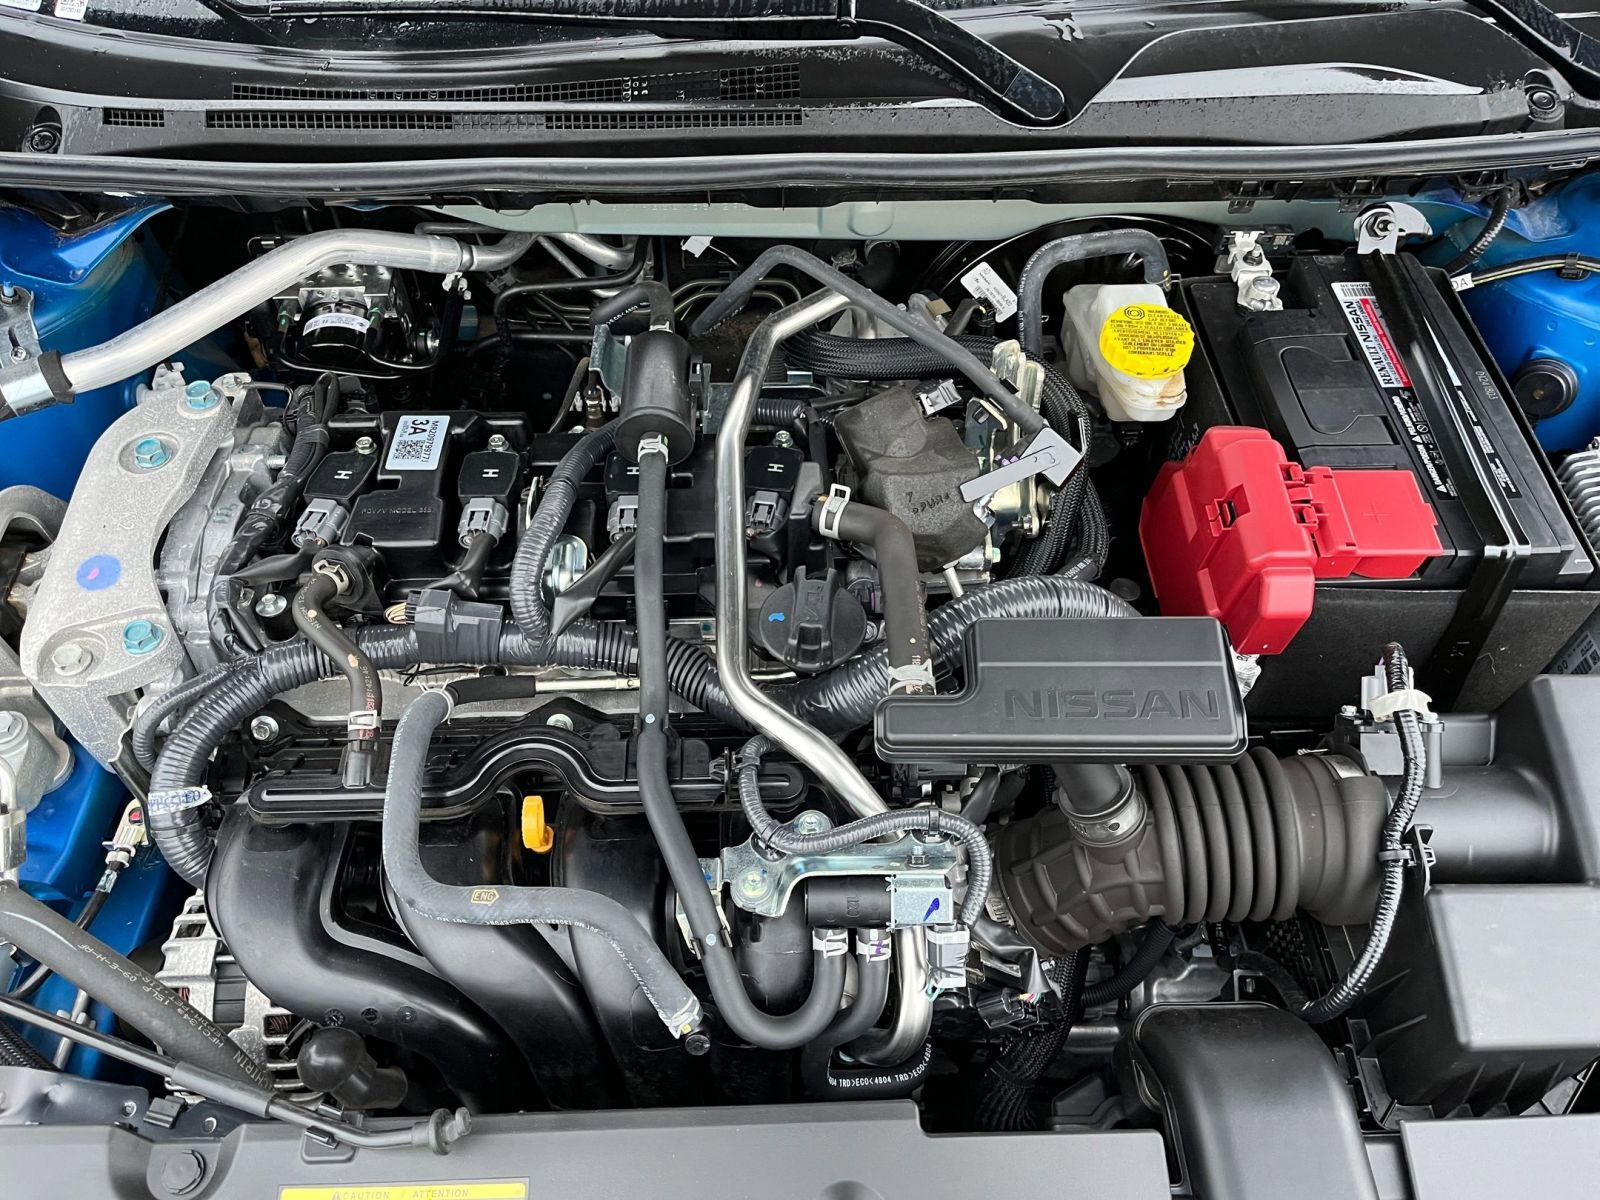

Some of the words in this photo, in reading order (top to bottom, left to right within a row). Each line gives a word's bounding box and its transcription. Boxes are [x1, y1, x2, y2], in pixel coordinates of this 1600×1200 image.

[1344, 301, 1372, 342] NISSAN
[1366, 344, 1394, 384] RENAULT
[408, 420, 430, 436] 3A
[301, 606, 322, 630] NISSAN
[1004, 690, 1220, 720] NISSAN
[474, 890, 495, 900] ENG
[142, 986, 170, 1006] 15LP
[176, 1008, 224, 1048] HFC134a
[343, 1191, 390, 1200] CAUTION
[412, 1189, 469, 1198] ATTENTION
